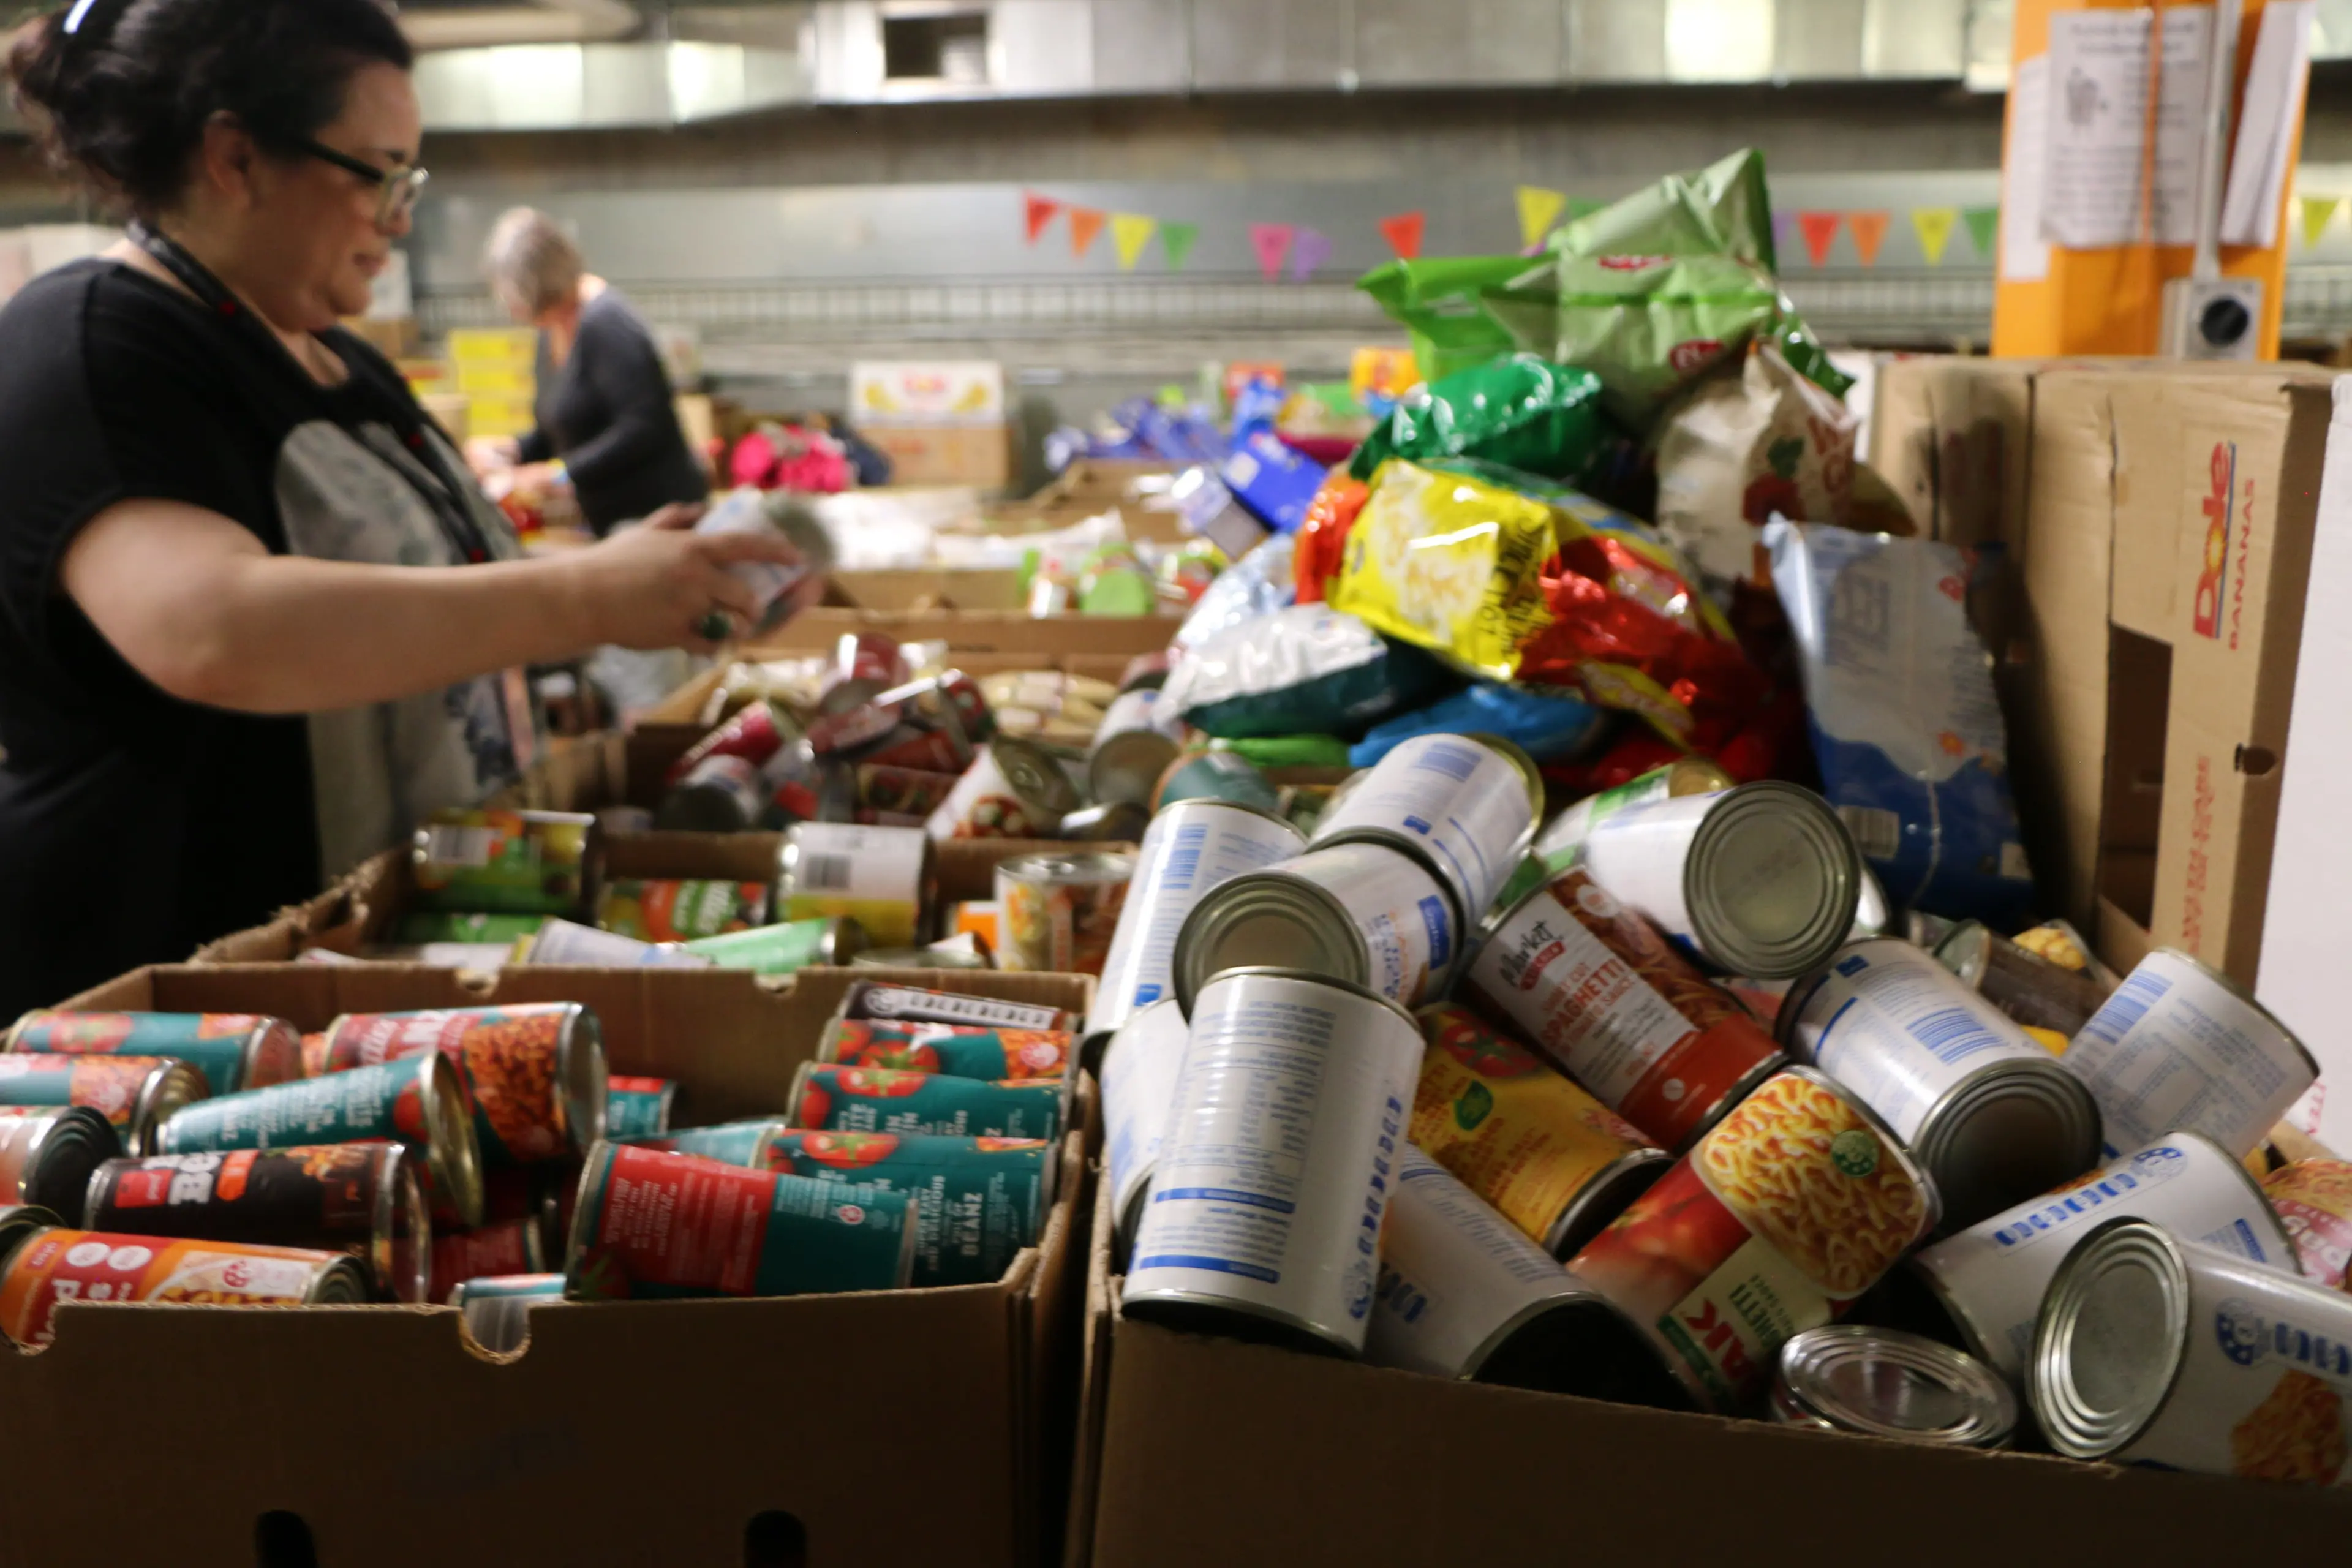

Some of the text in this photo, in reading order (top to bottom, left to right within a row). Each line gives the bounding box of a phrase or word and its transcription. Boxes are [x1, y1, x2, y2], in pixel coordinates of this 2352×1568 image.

[2193, 442, 2228, 638] Dole
[2230, 478, 2255, 650] BANANAS
[1499, 922, 1562, 986] Market
[1542, 959, 1624, 1045] SPAGHETTI
